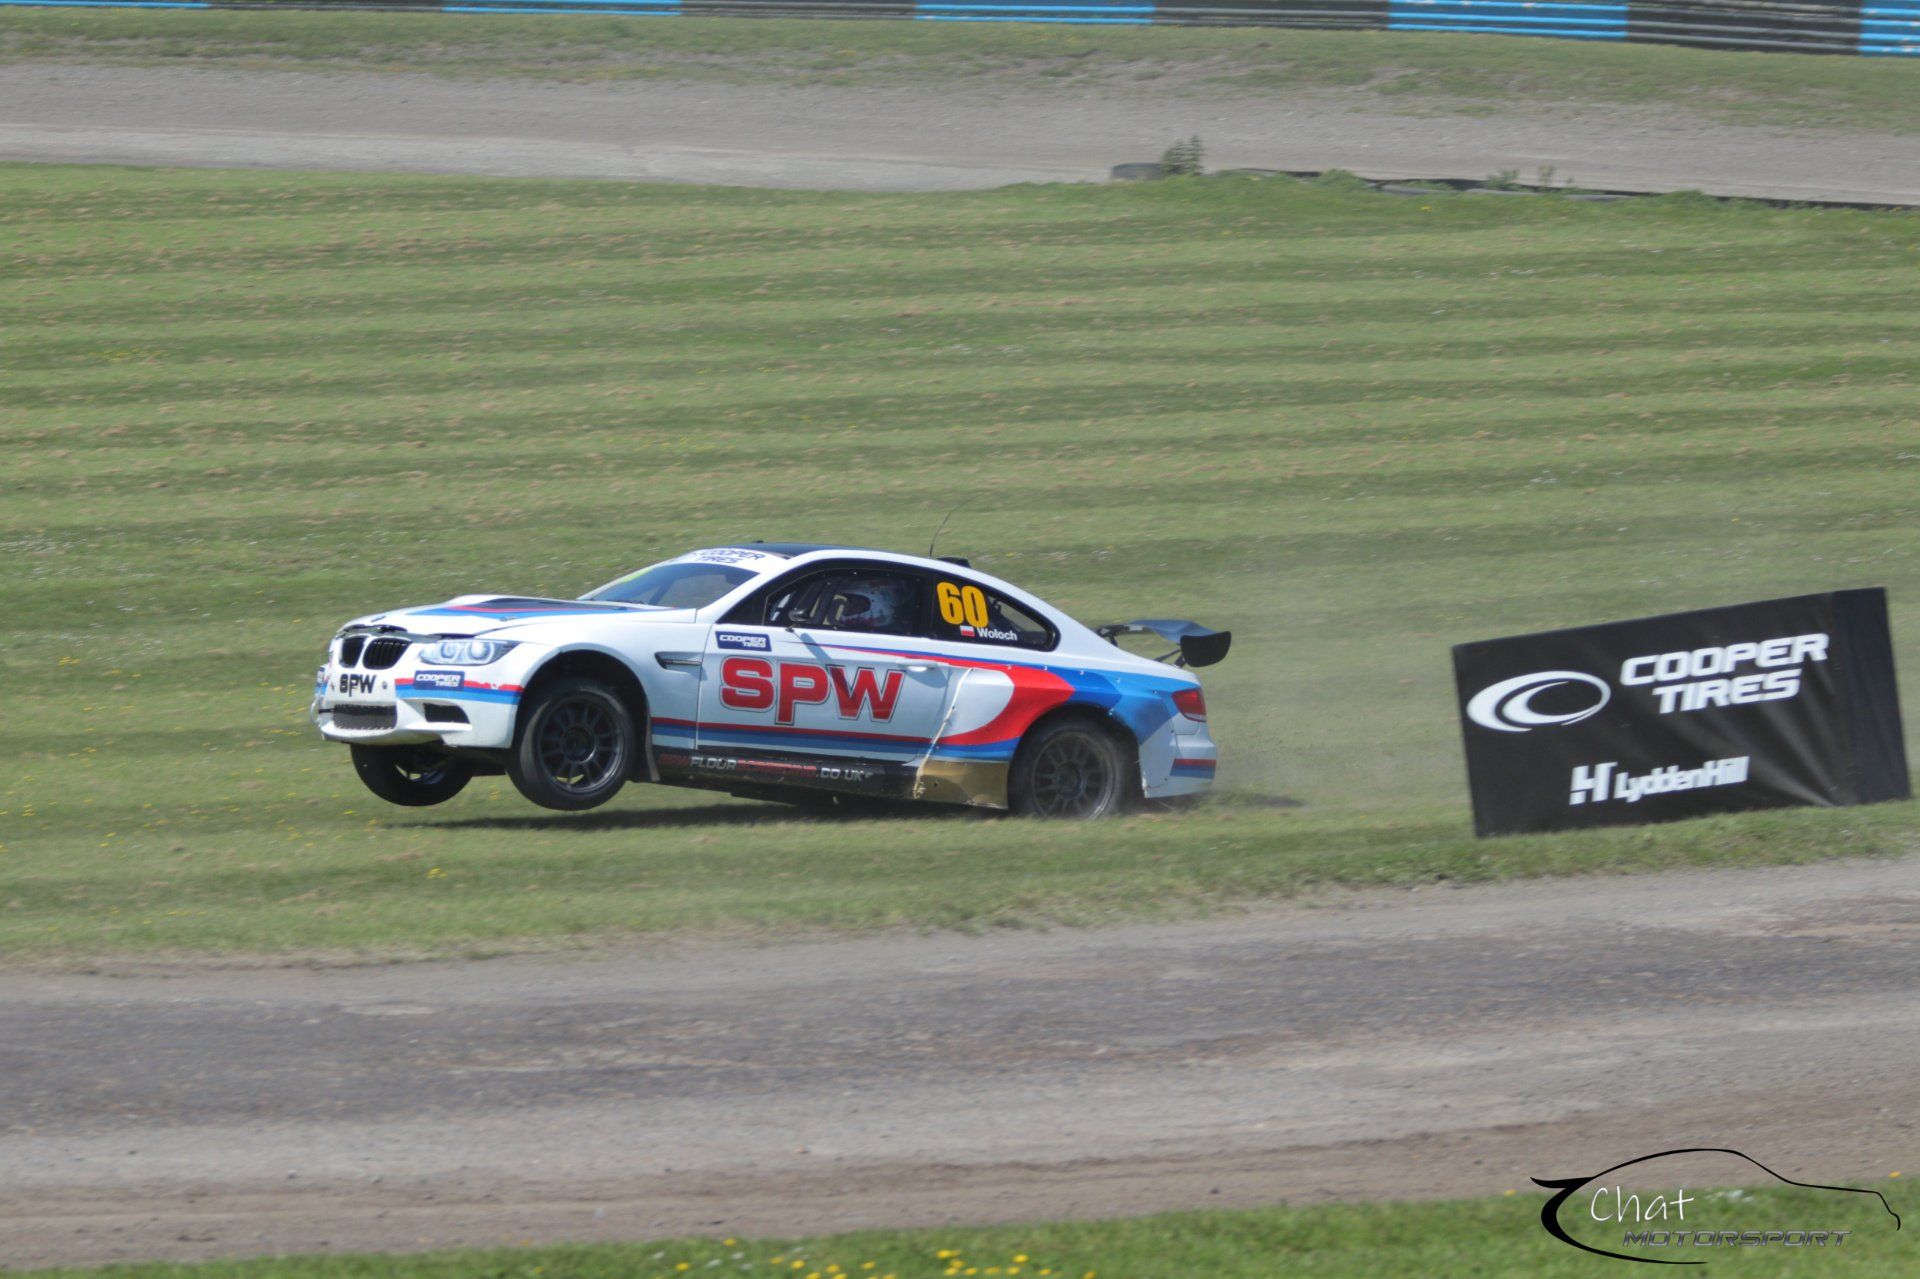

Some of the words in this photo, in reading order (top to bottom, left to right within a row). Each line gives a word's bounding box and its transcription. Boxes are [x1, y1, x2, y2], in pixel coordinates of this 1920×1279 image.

[936, 581, 989, 628] 60
[719, 634, 767, 644] COOPER
[1619, 632, 1830, 687] COOPER
[339, 673, 377, 697] SPW
[416, 673, 462, 683] COOPER
[719, 655, 907, 726] SPW
[1652, 668, 1802, 714] TIRES
